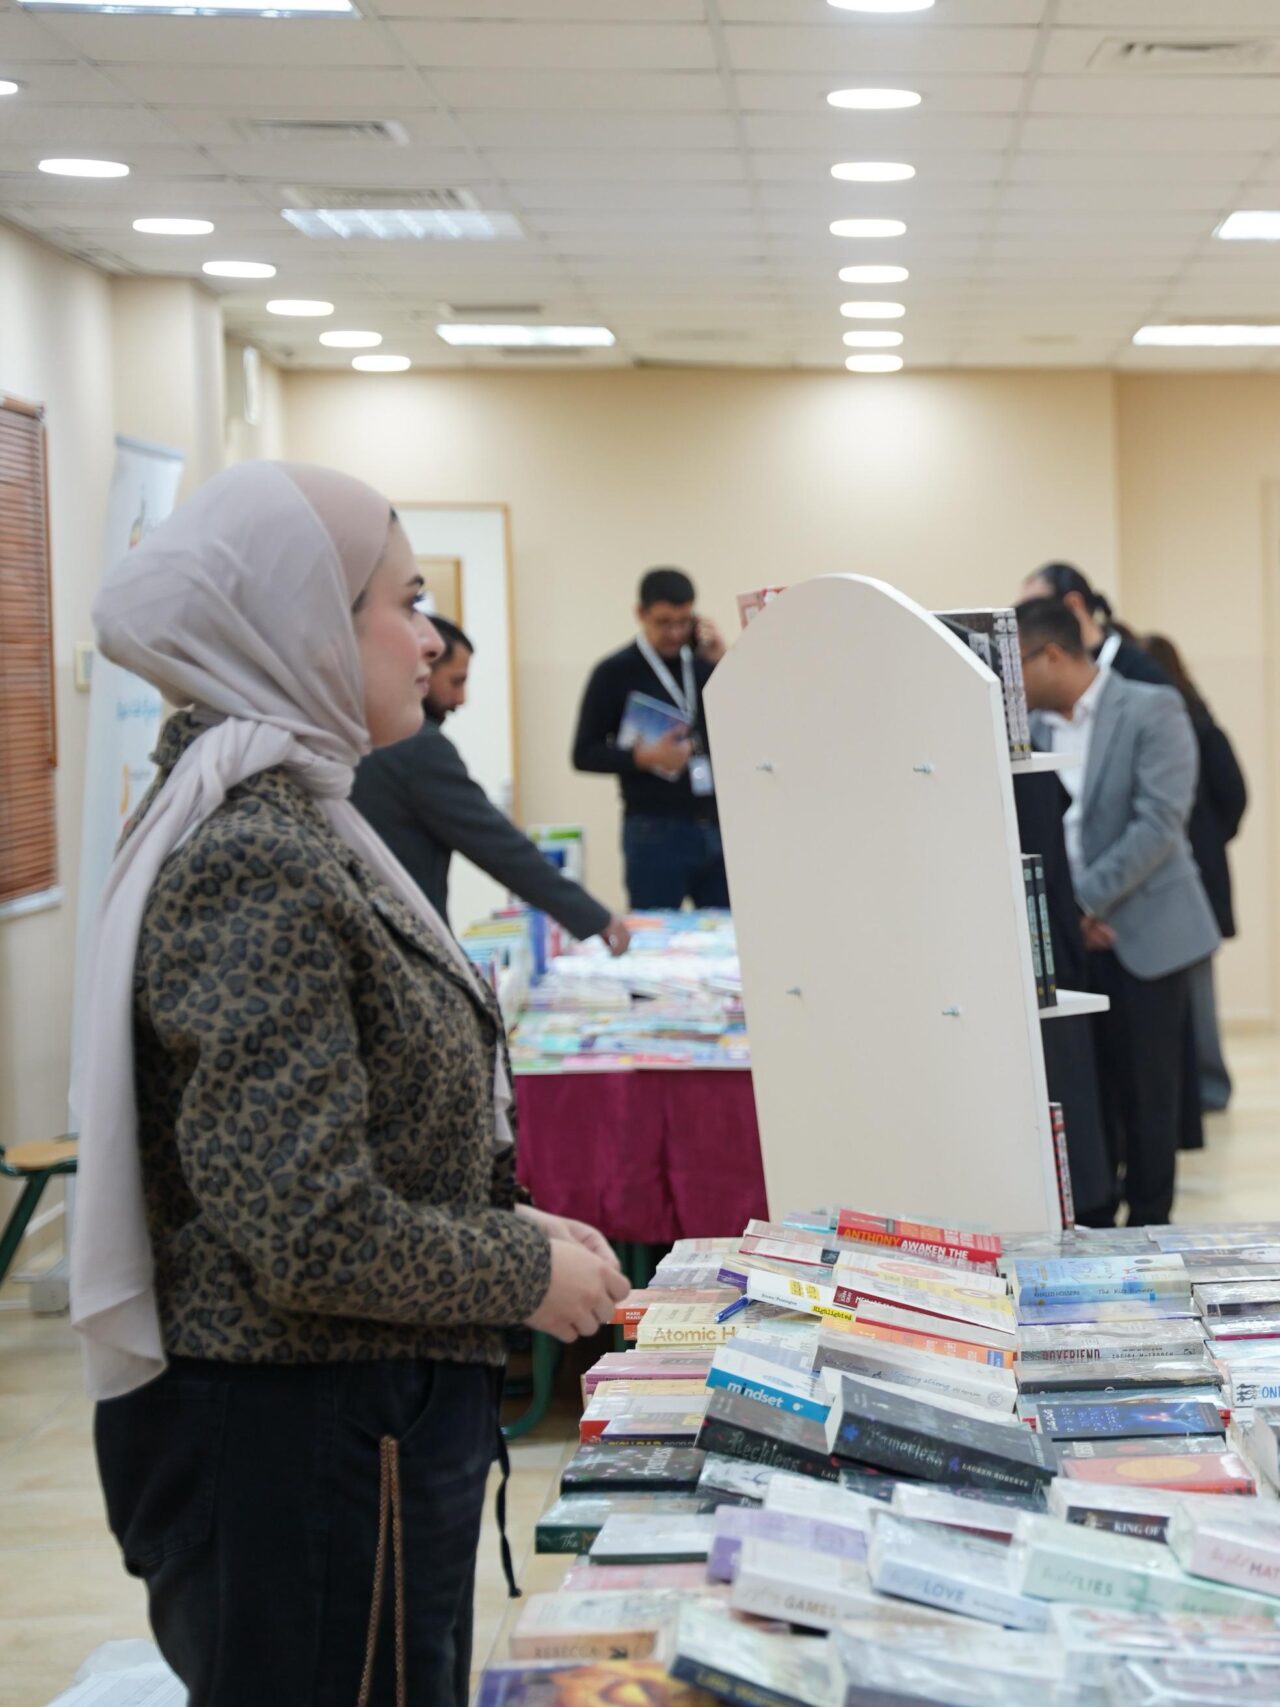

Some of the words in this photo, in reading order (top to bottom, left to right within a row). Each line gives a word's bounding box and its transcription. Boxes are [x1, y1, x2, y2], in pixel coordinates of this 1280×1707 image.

[843, 1227, 901, 1248] ANTHONY
[901, 1239, 946, 1256] AWAKEN
[949, 1248, 969, 1260] THE
[813, 1304, 852, 1321] Highlighted
[653, 1326, 716, 1343] Atomic
[726, 1381, 784, 1408] mindset
[961, 1463, 993, 1479] LAUREN
[994, 1472, 1029, 1488] ROBERTS
[1113, 1520, 1142, 1535] KING
[1144, 1525, 1161, 1537] OF
[923, 1581, 965, 1601] LOVE
